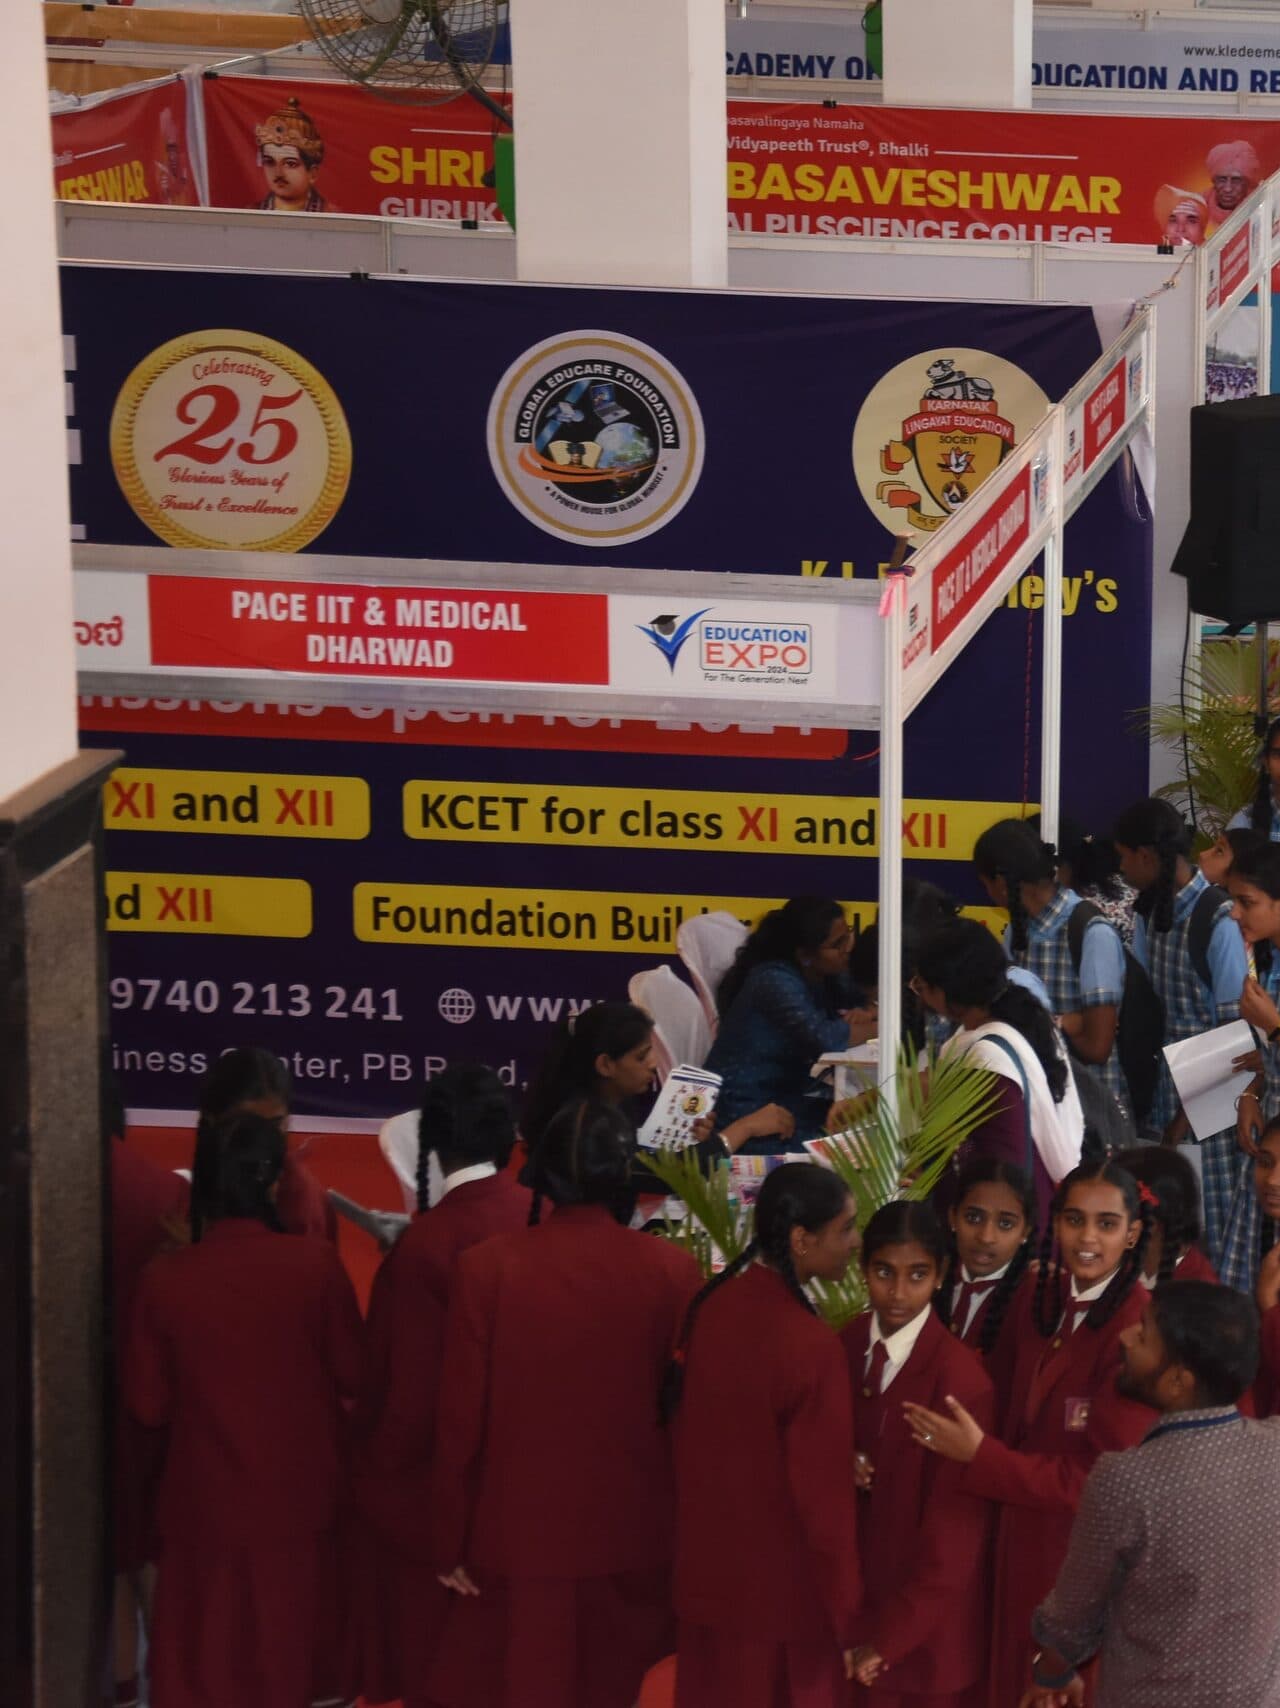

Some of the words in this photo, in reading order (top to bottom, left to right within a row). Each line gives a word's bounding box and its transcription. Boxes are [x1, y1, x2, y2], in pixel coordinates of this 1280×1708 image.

[1032, 63, 1167, 91] DUCATION
[1178, 67, 1238, 93] AND
[813, 117, 864, 131] Namaha
[727, 136, 813, 154] Vidyapeeth
[879, 143, 929, 157] Bhalki
[369, 146, 486, 188] SHRI
[728, 161, 1121, 214] BASAVESHWAR
[815, 215, 960, 240] SCIENCE
[192, 356, 275, 387] Celebrating
[518, 386, 550, 438] GLOBAL
[548, 364, 613, 388] EDUCARE
[615, 368, 676, 445] FOUNDATION
[926, 399, 990, 413] KARNATAK
[153, 384, 304, 465] 25
[905, 415, 951, 436] LINGAYAT
[953, 416, 1013, 439] EDUCATION
[938, 435, 977, 445] SOCIETY
[168, 467, 225, 486] Glorious
[230, 469, 268, 487] Years
[271, 471, 290, 493] of
[159, 494, 203, 513] Trust
[217, 496, 299, 516] Excellence
[231, 591, 308, 623] PACE
[317, 595, 354, 625] IIT
[363, 597, 387, 626] &
[396, 599, 528, 633] MEDICAL
[704, 626, 807, 644] EDUCATION
[306, 634, 454, 669] DHARWAD
[705, 642, 807, 669] EXPO
[704, 672, 718, 683] For
[720, 673, 736, 683] The
[738, 674, 786, 685] Generation
[788, 676, 808, 686] Next
[766, 665, 788, 675] 2024
[111, 781, 156, 819] XI
[172, 785, 259, 823] and
[275, 788, 333, 826] XII
[421, 793, 528, 831] KCET
[541, 796, 605, 835] for
[619, 800, 723, 840] class
[737, 806, 778, 842] XI
[794, 809, 876, 846] and
[901, 812, 947, 848] XII
[157, 886, 213, 923] XII
[372, 896, 596, 940] Foundation
[110, 977, 220, 1014] 9740
[232, 982, 312, 1017] 213
[324, 986, 404, 1021] 241
[112, 1044, 209, 1075] iness
[363, 1053, 413, 1081] PB
[424, 1056, 529, 1091] Rd,
